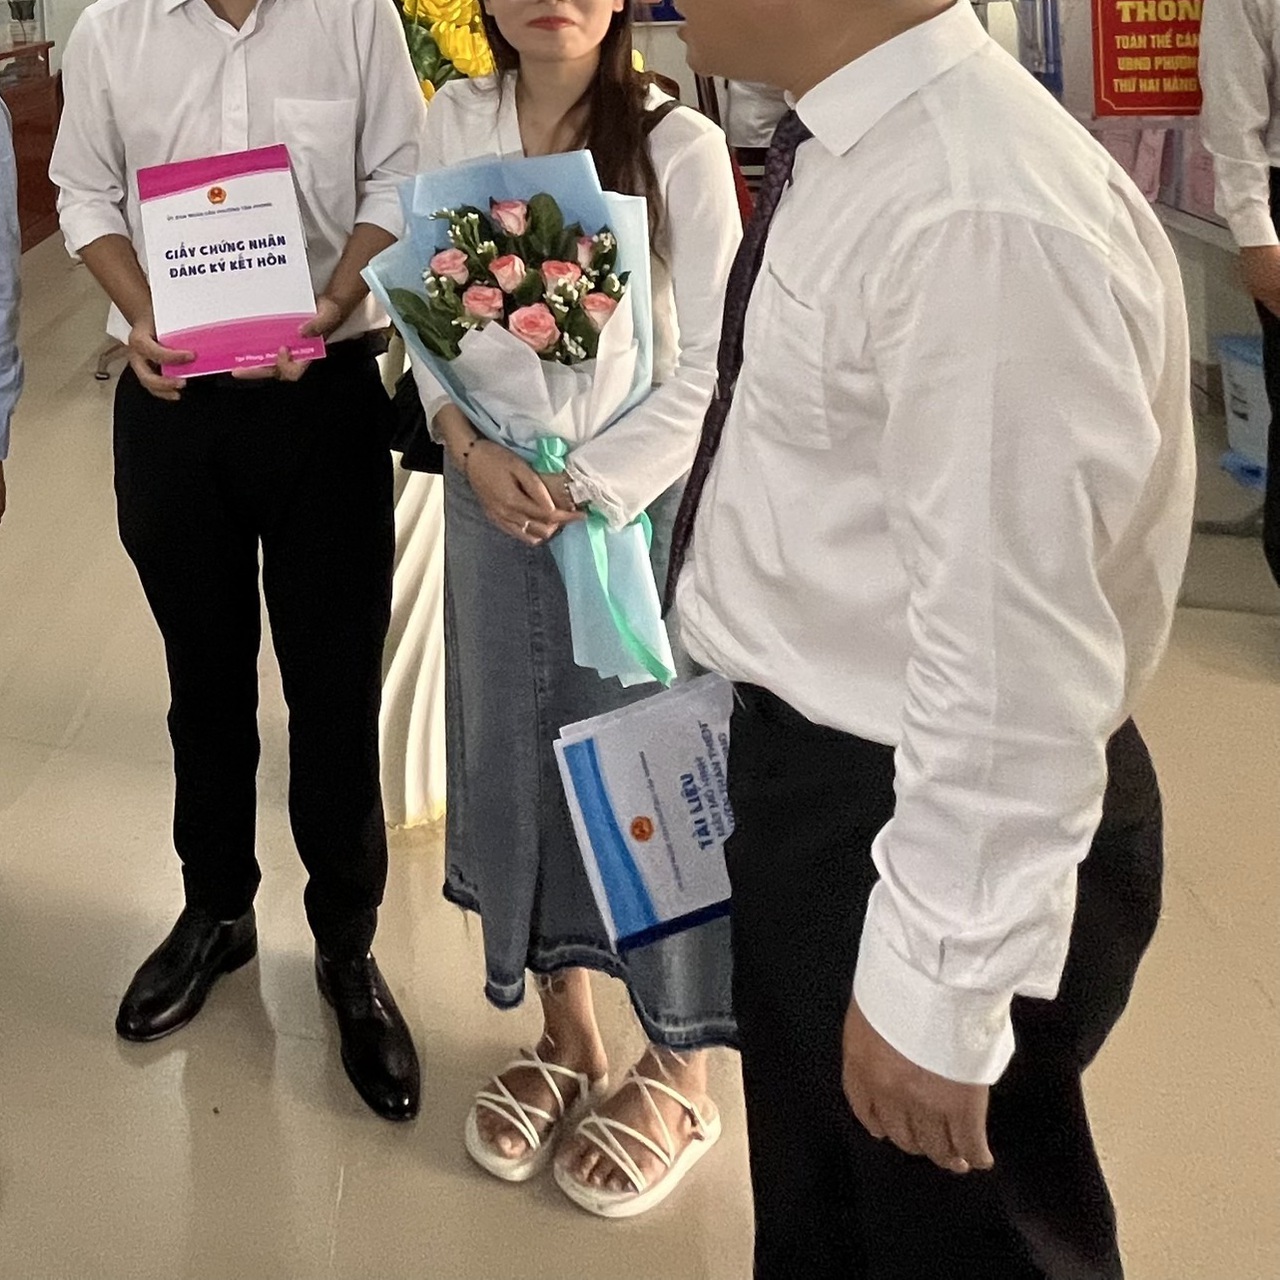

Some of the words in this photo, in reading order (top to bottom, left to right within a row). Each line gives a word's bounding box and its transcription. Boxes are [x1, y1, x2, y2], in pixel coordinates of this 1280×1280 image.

[1115, 31, 1147, 49] TOÀN
[1118, 56, 1151, 71] UBND
[165, 242, 196, 260] GIẤY
[199, 239, 245, 256] CHỨNG
[249, 233, 286, 250] NHẬN
[169, 263, 207, 278] ĐĂNG
[209, 258, 226, 273] KÝ
[229, 253, 253, 271] KẾT
[257, 252, 287, 268] HÔN
[680, 773, 703, 814] LIỆU
